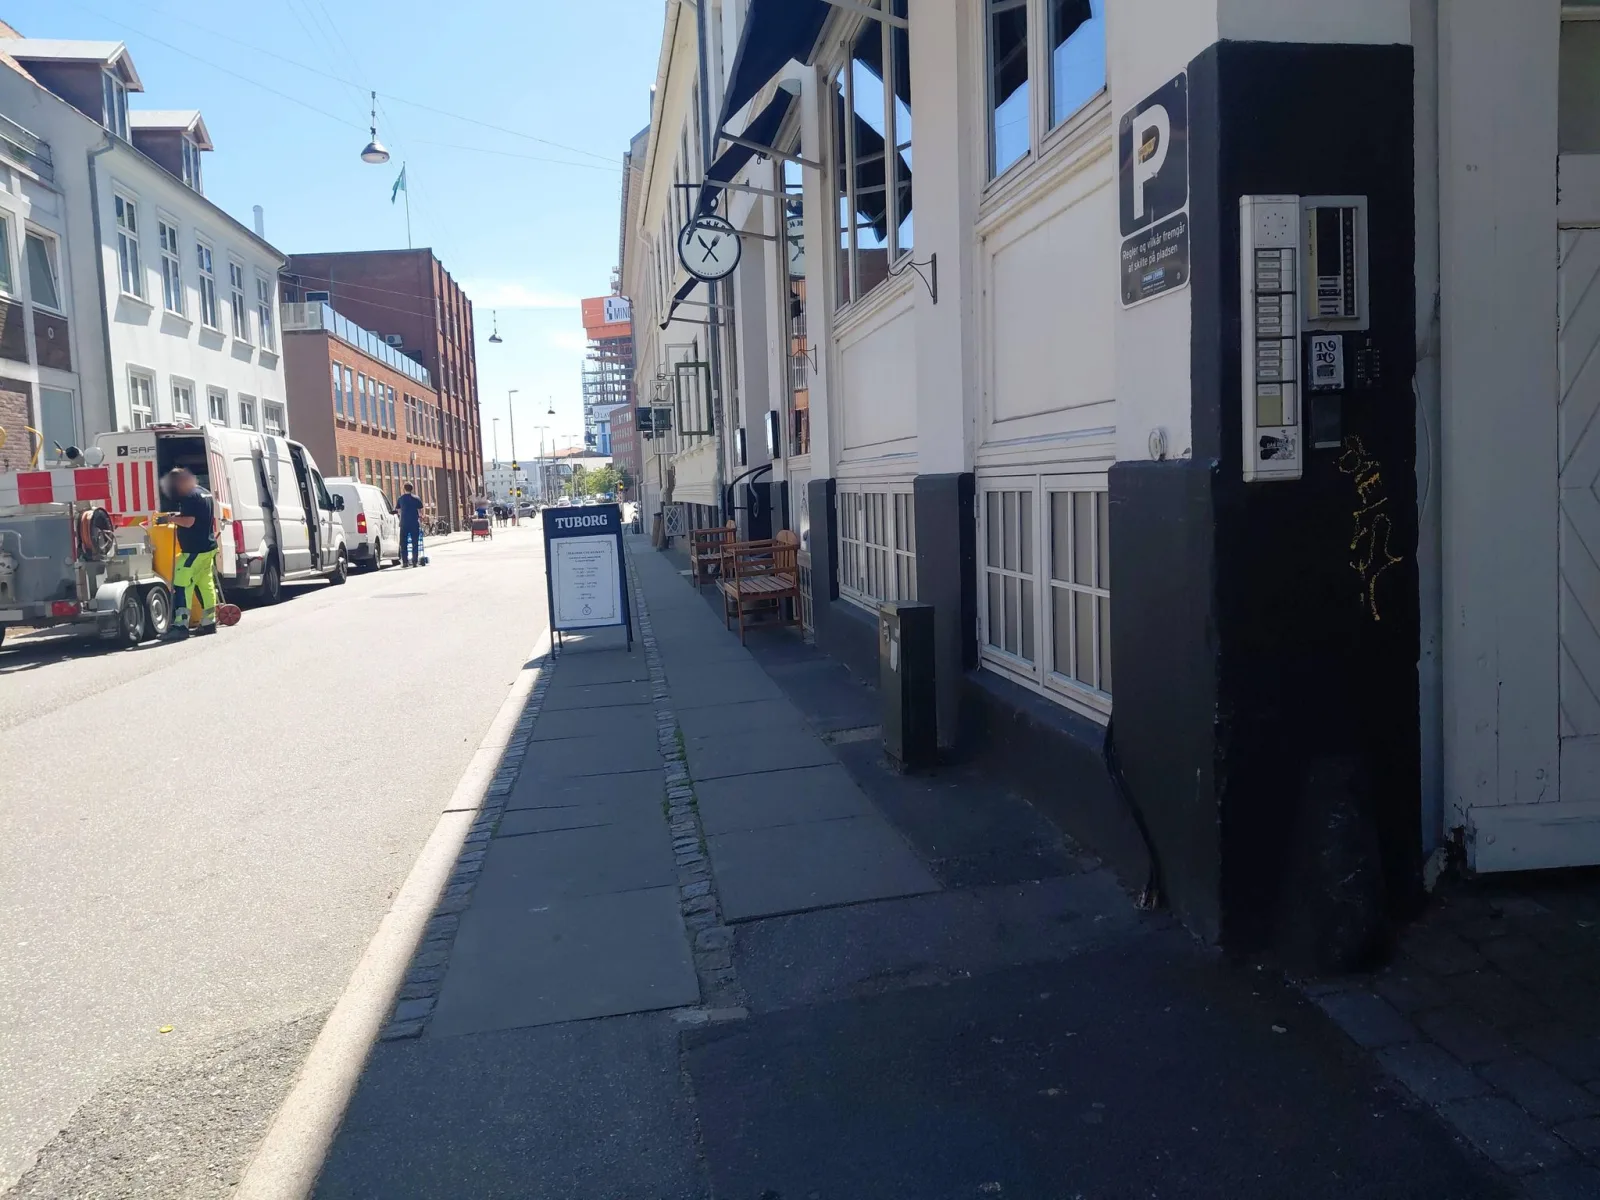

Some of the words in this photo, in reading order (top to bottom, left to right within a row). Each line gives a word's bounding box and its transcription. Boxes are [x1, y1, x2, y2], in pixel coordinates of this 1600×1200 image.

[1133, 103, 1170, 220] P
[1123, 246, 1138, 260] Regler
[1139, 243, 1147, 253] og
[1147, 233, 1162, 248] vilkår
[1163, 221, 1186, 241] fremgår
[1128, 263, 1134, 273] af
[1134, 256, 1149, 271] skilte
[1149, 250, 1156, 267] på
[1156, 244, 1178, 262] pladsen
[555, 514, 608, 529] TUBORG
